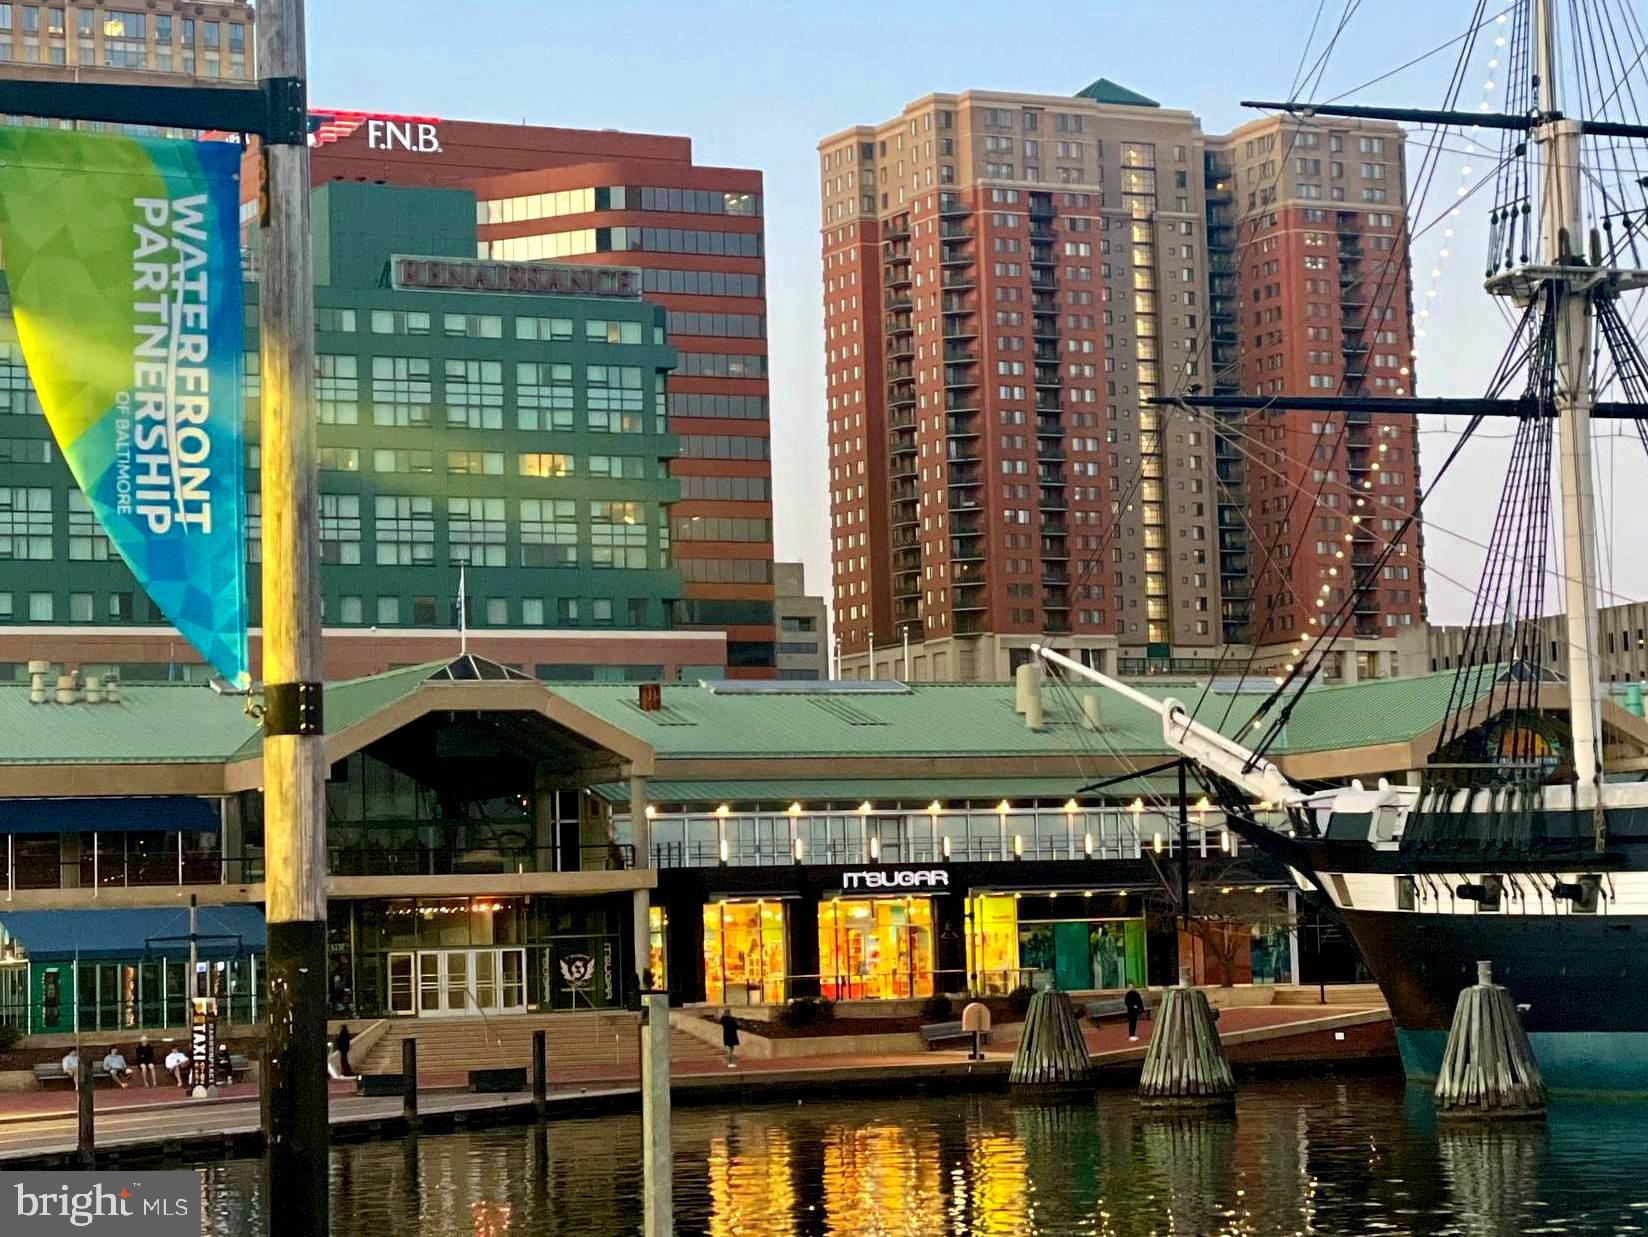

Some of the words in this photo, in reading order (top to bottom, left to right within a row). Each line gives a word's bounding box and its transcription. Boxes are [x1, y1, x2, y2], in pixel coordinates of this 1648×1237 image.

[401, 258, 635, 293] RENAISSANCE
[132, 197, 172, 534] PARTNERSHIP
[171, 194, 212, 534] WATERFRONT
[115, 391, 130, 415] OF
[115, 418, 132, 515] BALTIMORE
[193, 1023, 206, 1061] TAXI
